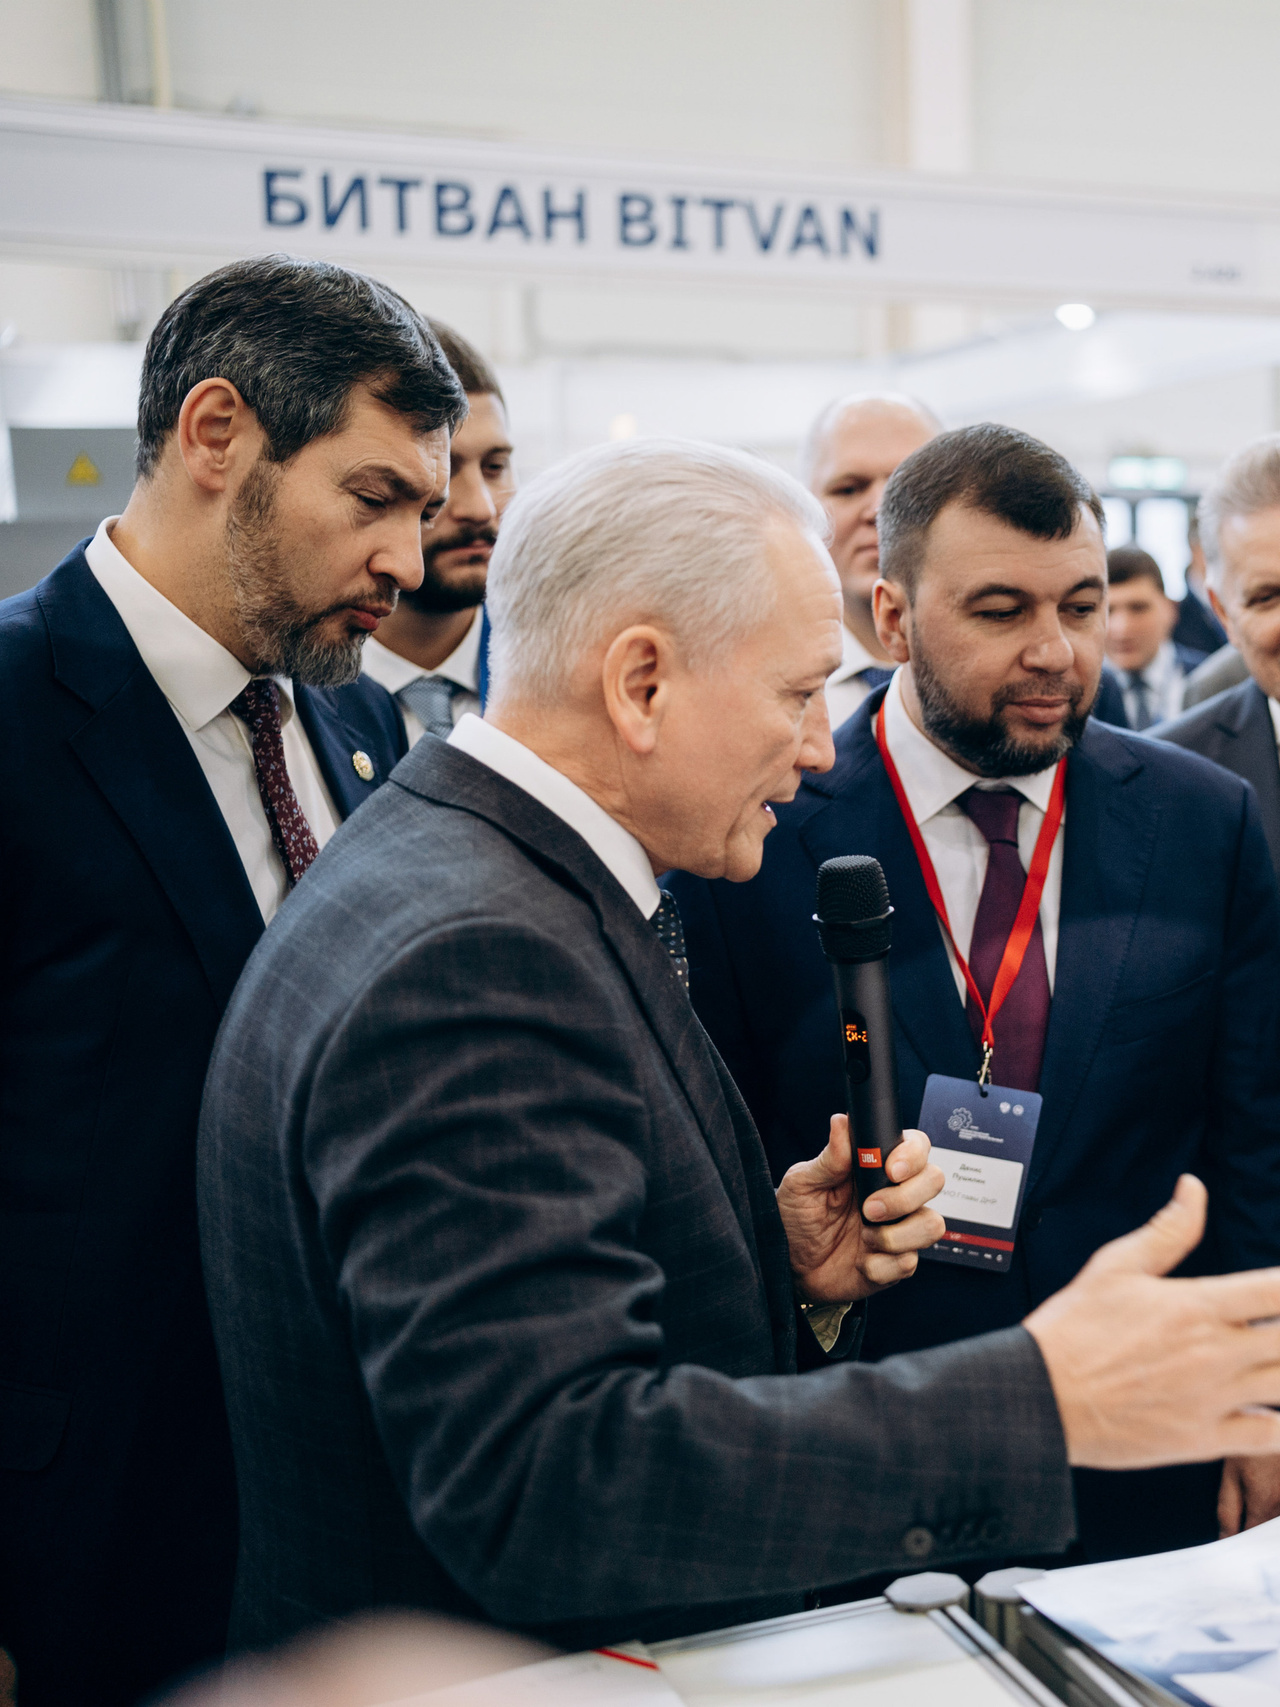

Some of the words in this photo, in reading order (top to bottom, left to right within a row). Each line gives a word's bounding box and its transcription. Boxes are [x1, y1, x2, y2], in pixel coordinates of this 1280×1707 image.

[262, 168, 588, 243] БИТВАН
[618, 194, 880, 259] BITVAN
[861, 1153, 877, 1163] JBL
